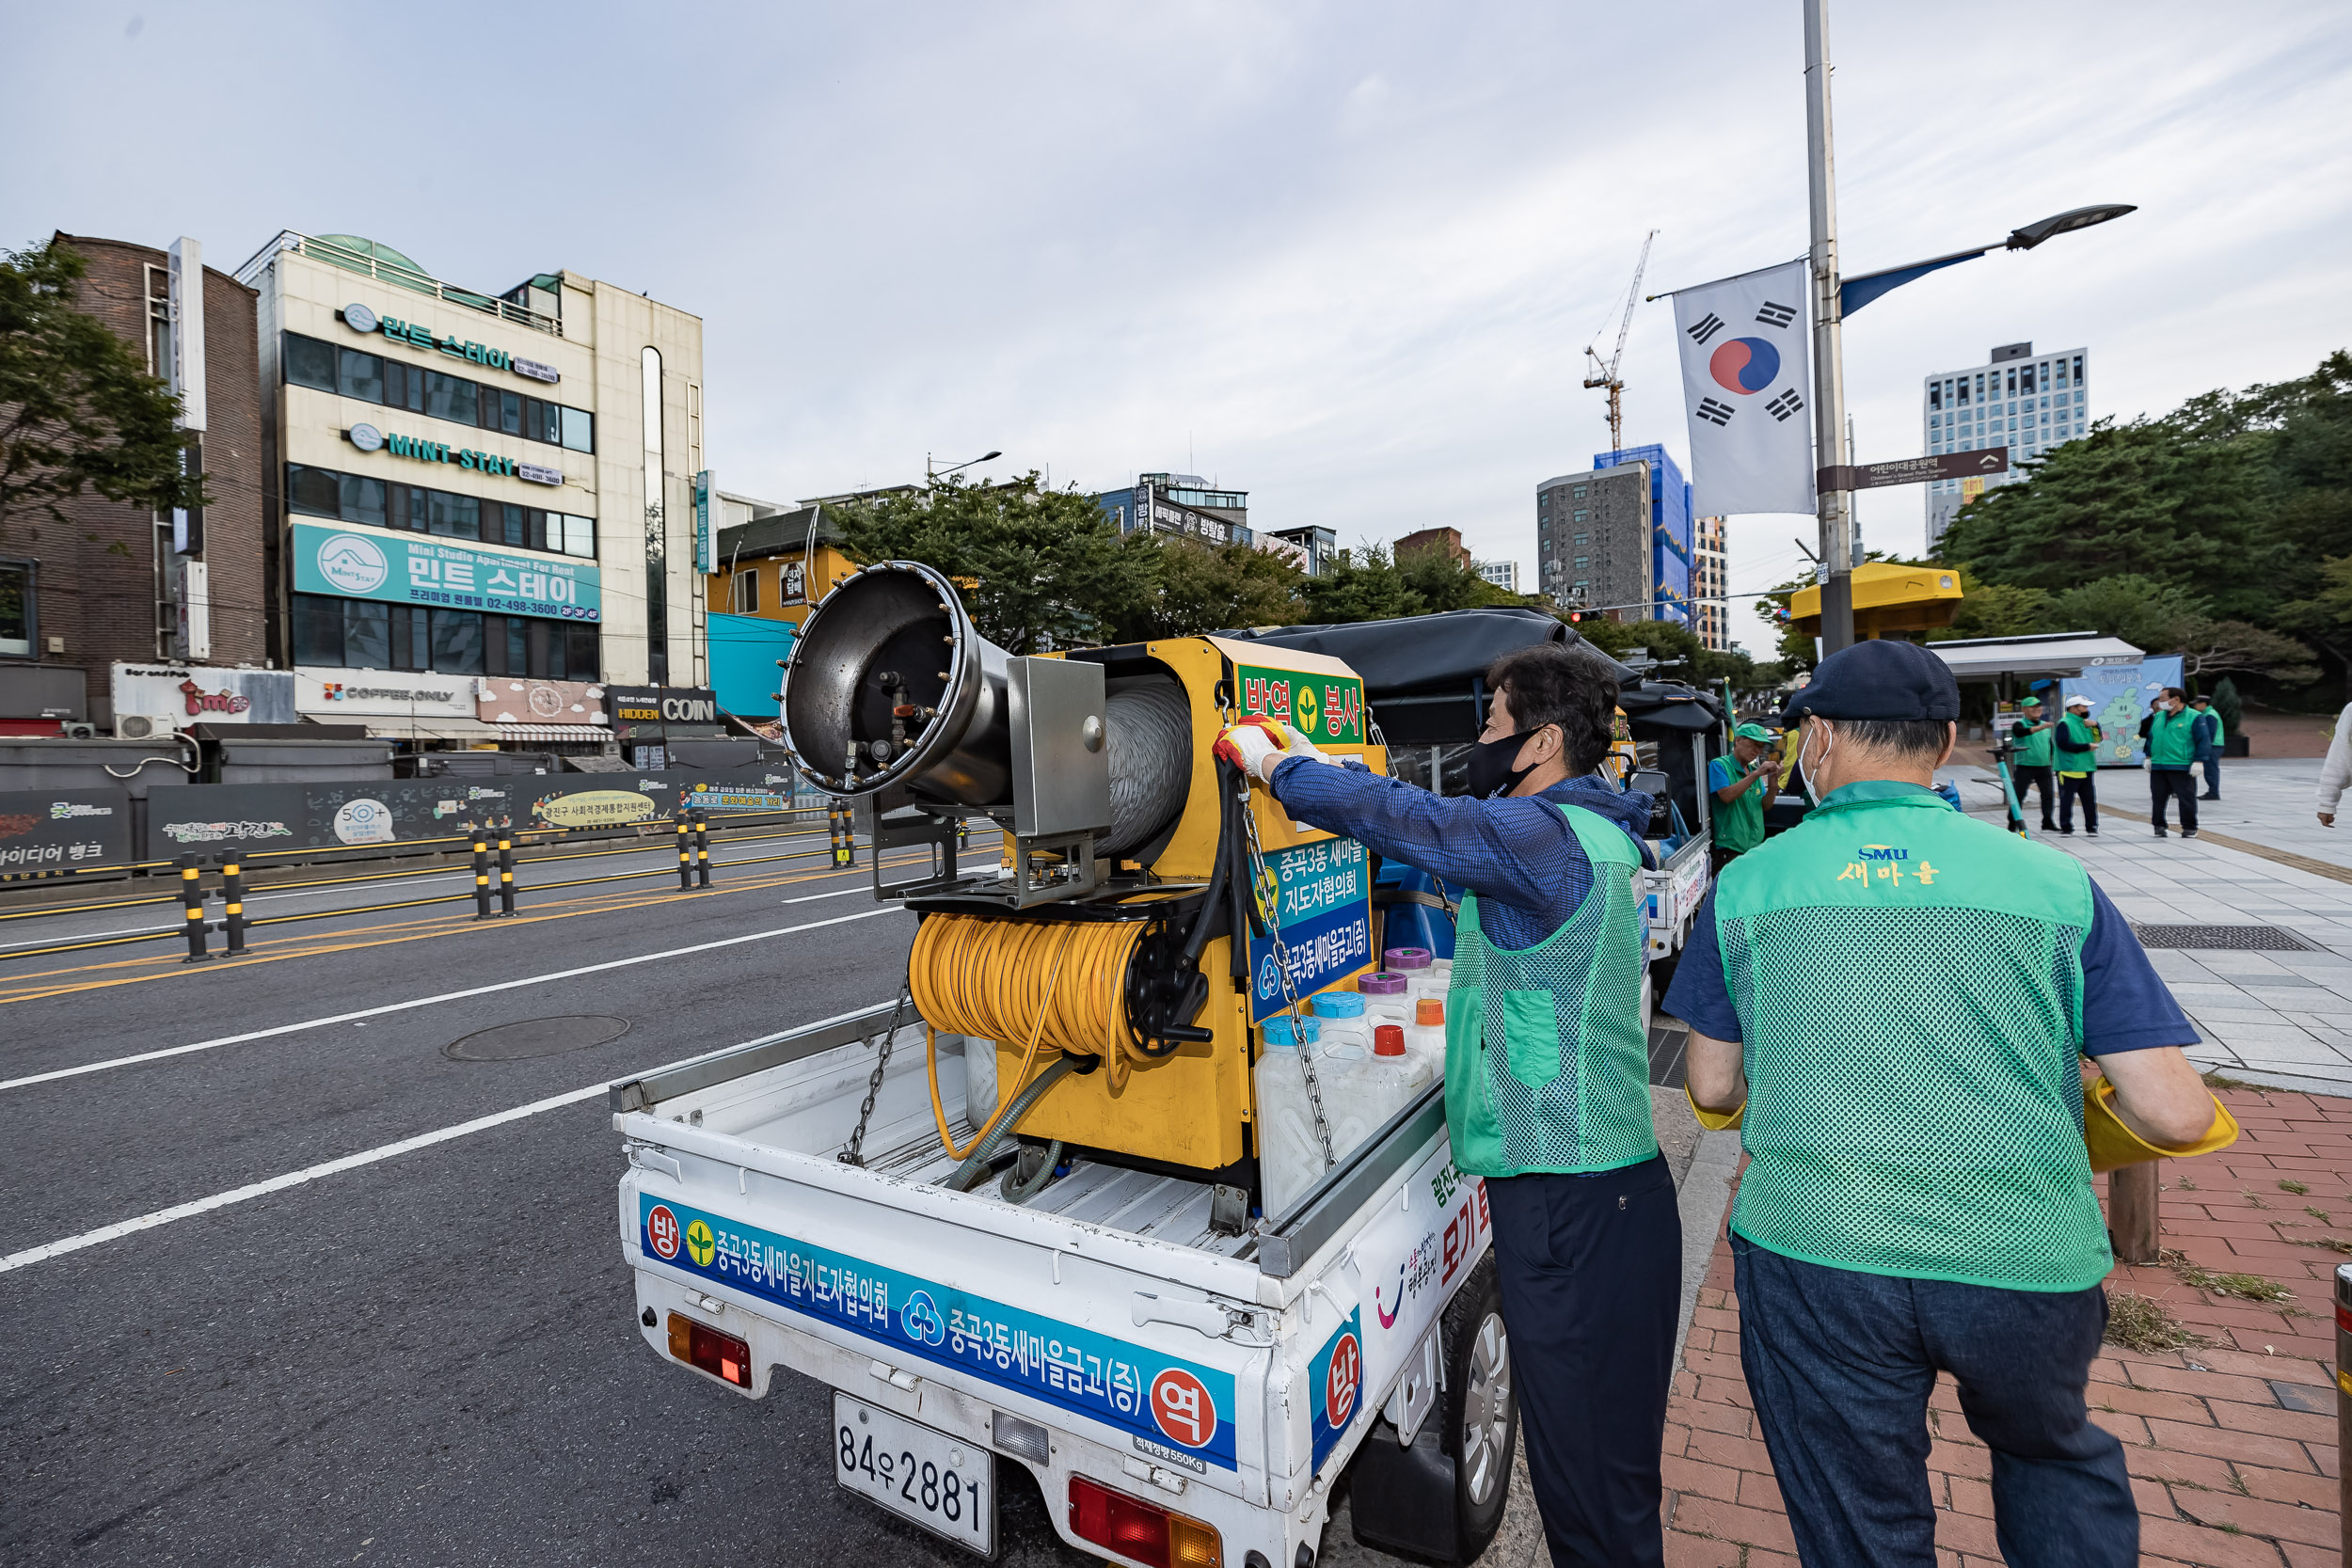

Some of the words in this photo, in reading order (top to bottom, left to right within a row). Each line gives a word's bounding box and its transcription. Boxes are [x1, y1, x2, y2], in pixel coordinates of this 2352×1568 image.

[382, 316, 434, 349] 민트
[440, 336, 511, 372] 스테이
[389, 433, 450, 465] MINT
[460, 449, 514, 477] STAY
[1870, 457, 1938, 474] 어린이대공원역
[699, 504, 707, 564] 민트스테이
[1200, 517, 1226, 542] 방탈출
[408, 543, 435, 556] Mini
[437, 547, 473, 562] Studio
[476, 554, 530, 570] Apartment
[532, 562, 550, 572] For
[551, 563, 575, 576] Rent
[408, 557, 475, 592] 민트
[486, 568, 577, 604] 스테이
[410, 589, 450, 603] 프리미엄
[487, 597, 557, 615] 02-498-3600
[562, 607, 572, 615] 2F
[574, 609, 585, 617] 3F
[587, 610, 597, 619] 4F
[346, 687, 411, 701] COFFEE
[415, 690, 454, 702] ONLY
[662, 698, 714, 721] COIN
[1324, 685, 1360, 736] 봉사
[618, 708, 659, 721] HIDDEN
[546, 806, 568, 817] 광진구
[693, 796, 718, 804] 능동로
[722, 795, 762, 806] 문화예술의
[765, 798, 780, 806] 거리
[69, 842, 103, 860] 뱅크
[1280, 846, 1328, 882] 중곡3동
[1329, 837, 1363, 868] 새마을
[1858, 847, 1908, 861] SMU
[1836, 861, 1940, 888] 새마을
[1285, 868, 1357, 916] 지도자협의회
[1442, 1194, 1475, 1288] 모기
[654, 1213, 676, 1259] 방
[717, 1230, 889, 1329] 중곡3동새마을지도자협의회
[948, 1308, 1141, 1417] 중곡3동새마을금고(증)
[1160, 1382, 1200, 1442] 역
[1332, 1343, 1358, 1416] 방
